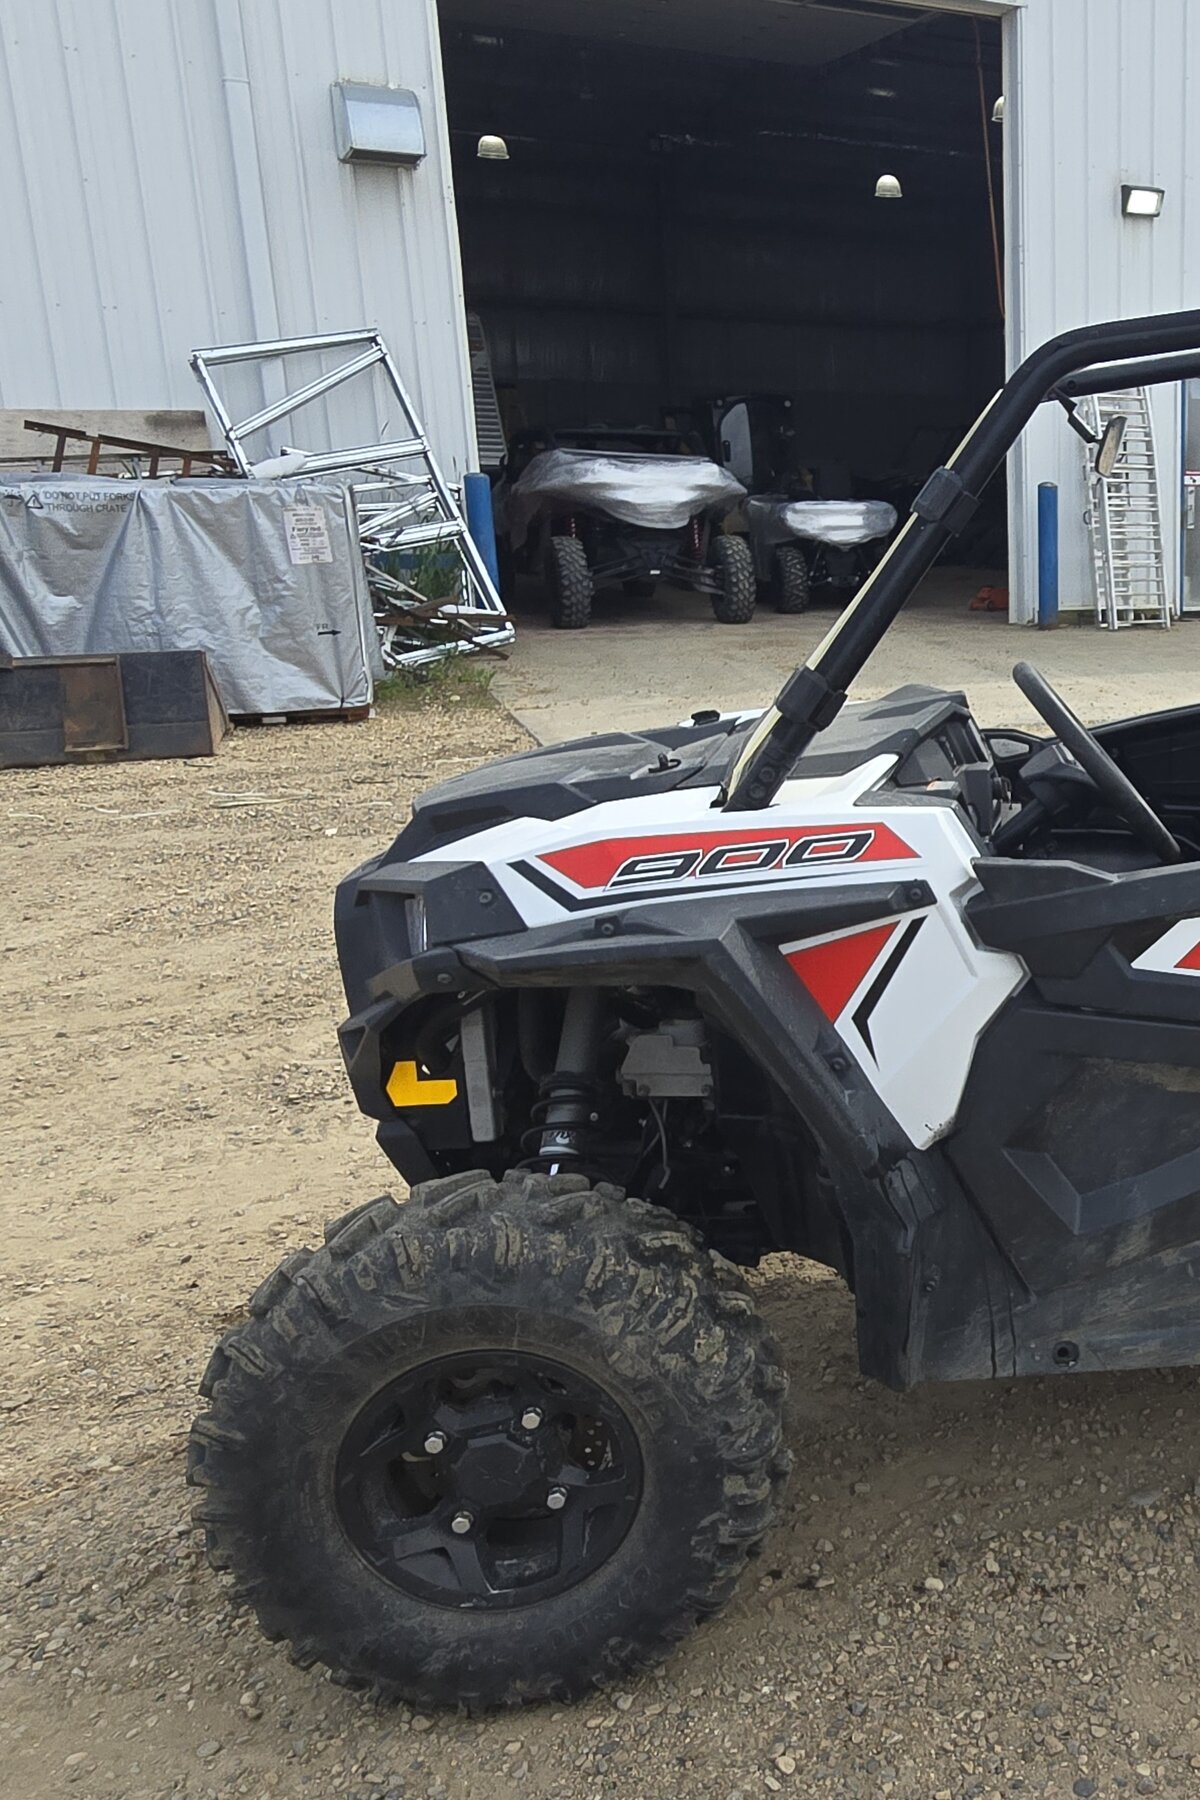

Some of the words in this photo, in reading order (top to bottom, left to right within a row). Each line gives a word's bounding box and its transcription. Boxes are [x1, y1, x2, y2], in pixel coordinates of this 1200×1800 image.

[44, 491, 60, 499] DO
[60, 491, 80, 500] NOT
[83, 492, 101, 500] PUT
[104, 492, 136, 501] FORKS
[46, 503, 94, 513] THROUGH
[95, 503, 127, 513] CRATE
[603, 830, 875, 892] 900
